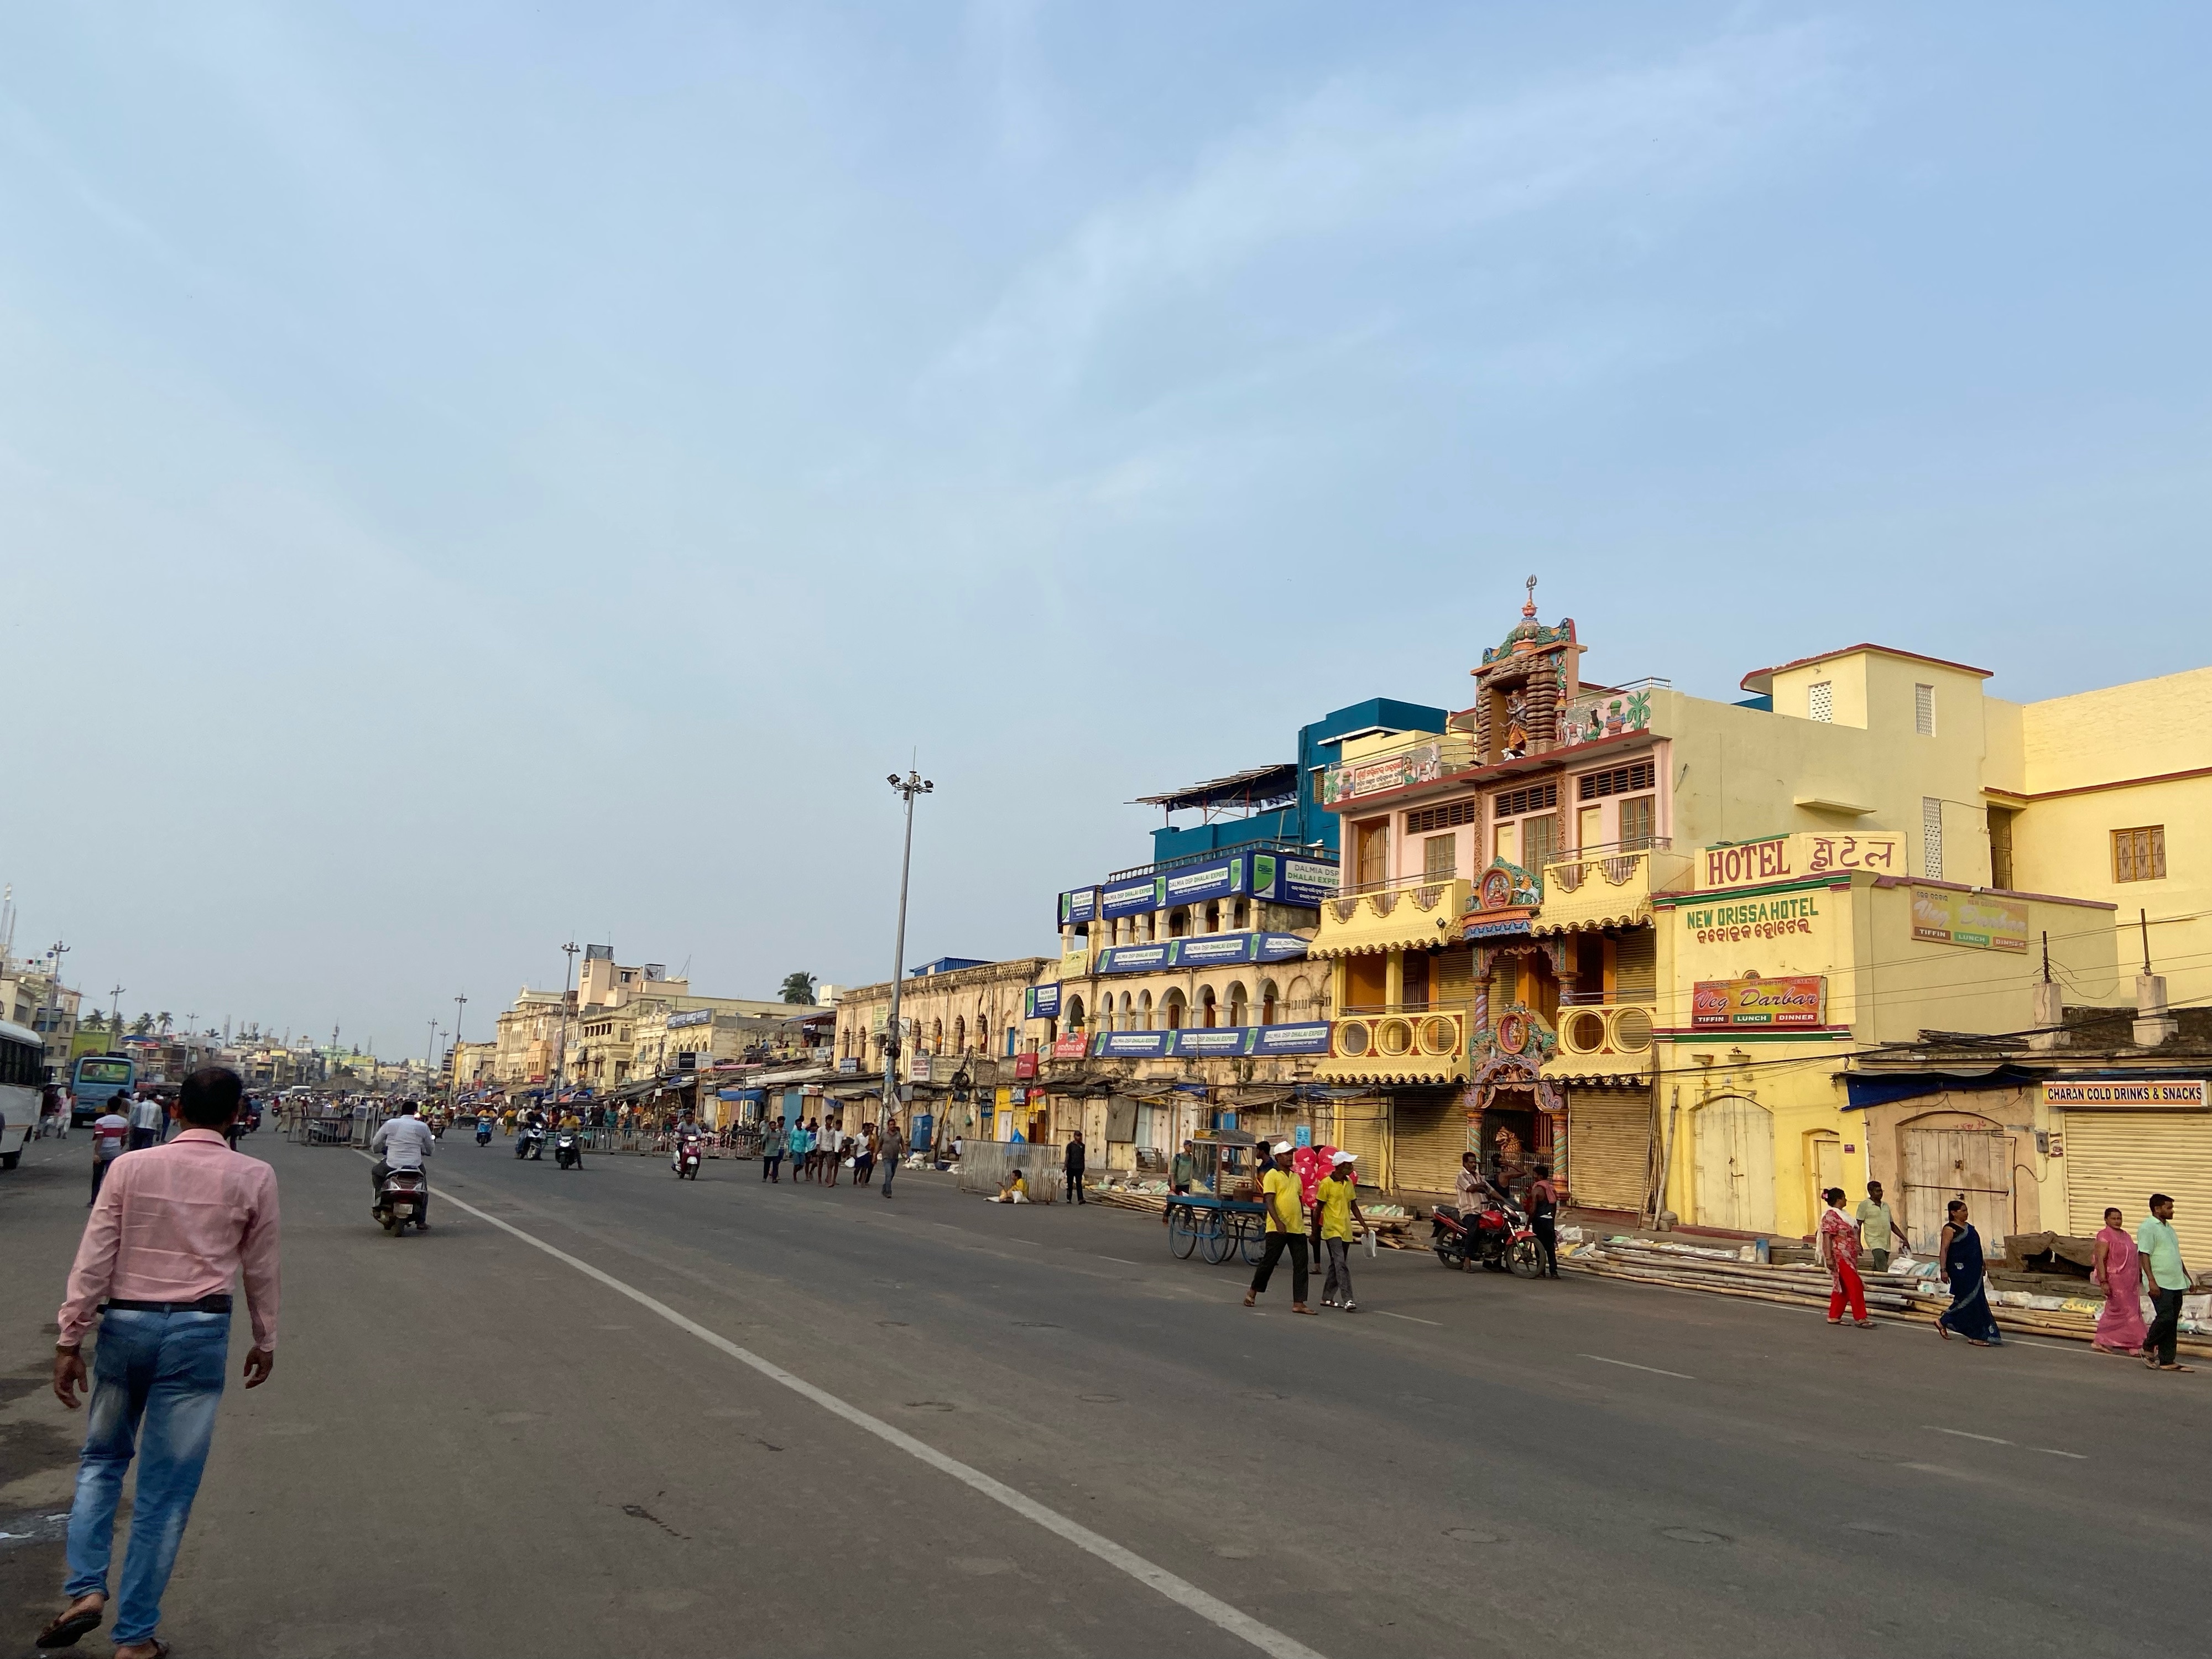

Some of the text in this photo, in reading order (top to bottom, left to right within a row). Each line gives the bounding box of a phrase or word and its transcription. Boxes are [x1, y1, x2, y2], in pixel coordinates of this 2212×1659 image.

[1708, 840, 1791, 885] HOTEL
[1295, 864, 1323, 874] DALMIA
[1211, 870, 1227, 879] EXPERT
[1288, 872, 1316, 882] DHALAI
[1139, 886, 1154, 894] EXPERT
[1687, 897, 1819, 929] NEW ORISSA HOTEL
[1919, 929, 1946, 937] TIFFIN
[1959, 934, 1985, 942] LUNCH
[1996, 939, 2025, 948] DINNER
[1694, 987, 1818, 1014] Veg Darbar
[2048, 1087, 2201, 1100] CHARAN COLD DRINKS & SNACKS
